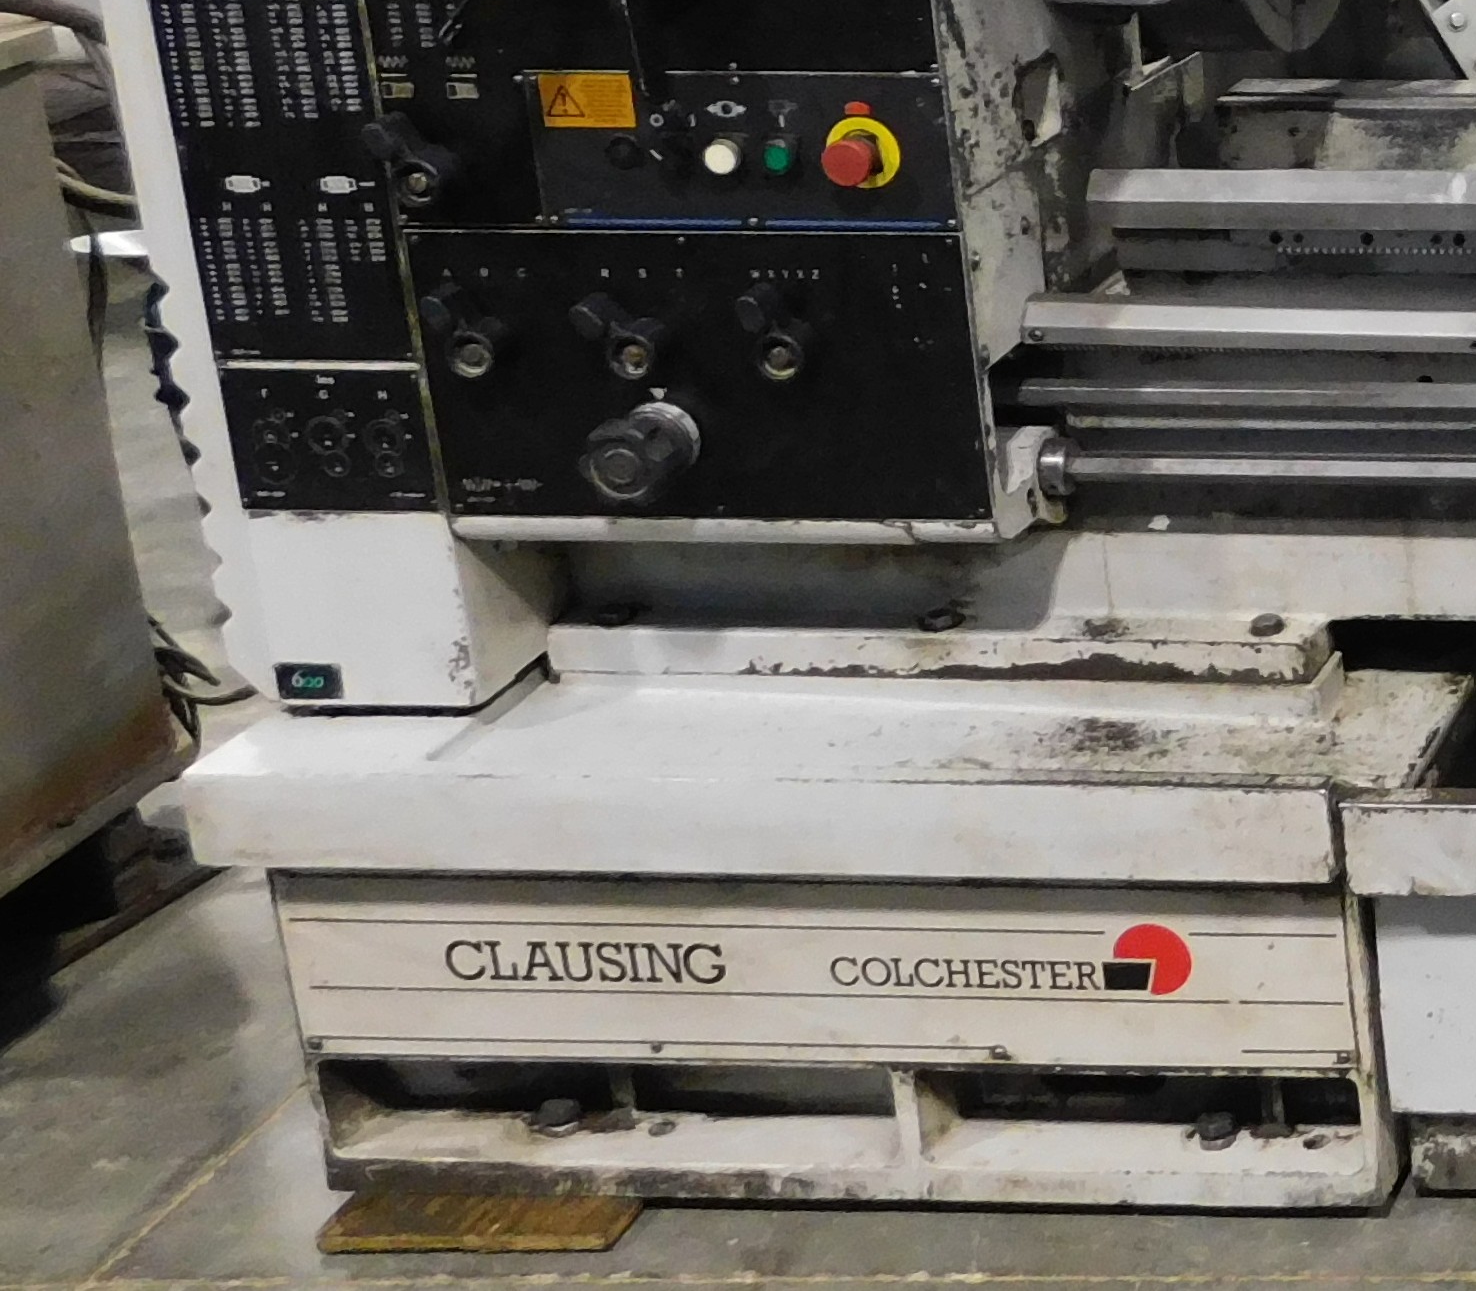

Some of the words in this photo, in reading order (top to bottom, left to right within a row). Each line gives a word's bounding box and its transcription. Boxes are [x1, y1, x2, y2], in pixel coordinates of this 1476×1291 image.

[291, 670, 325, 689] 600
[445, 940, 727, 985] CLAUSING
[829, 956, 1102, 992] COLCHESTER
